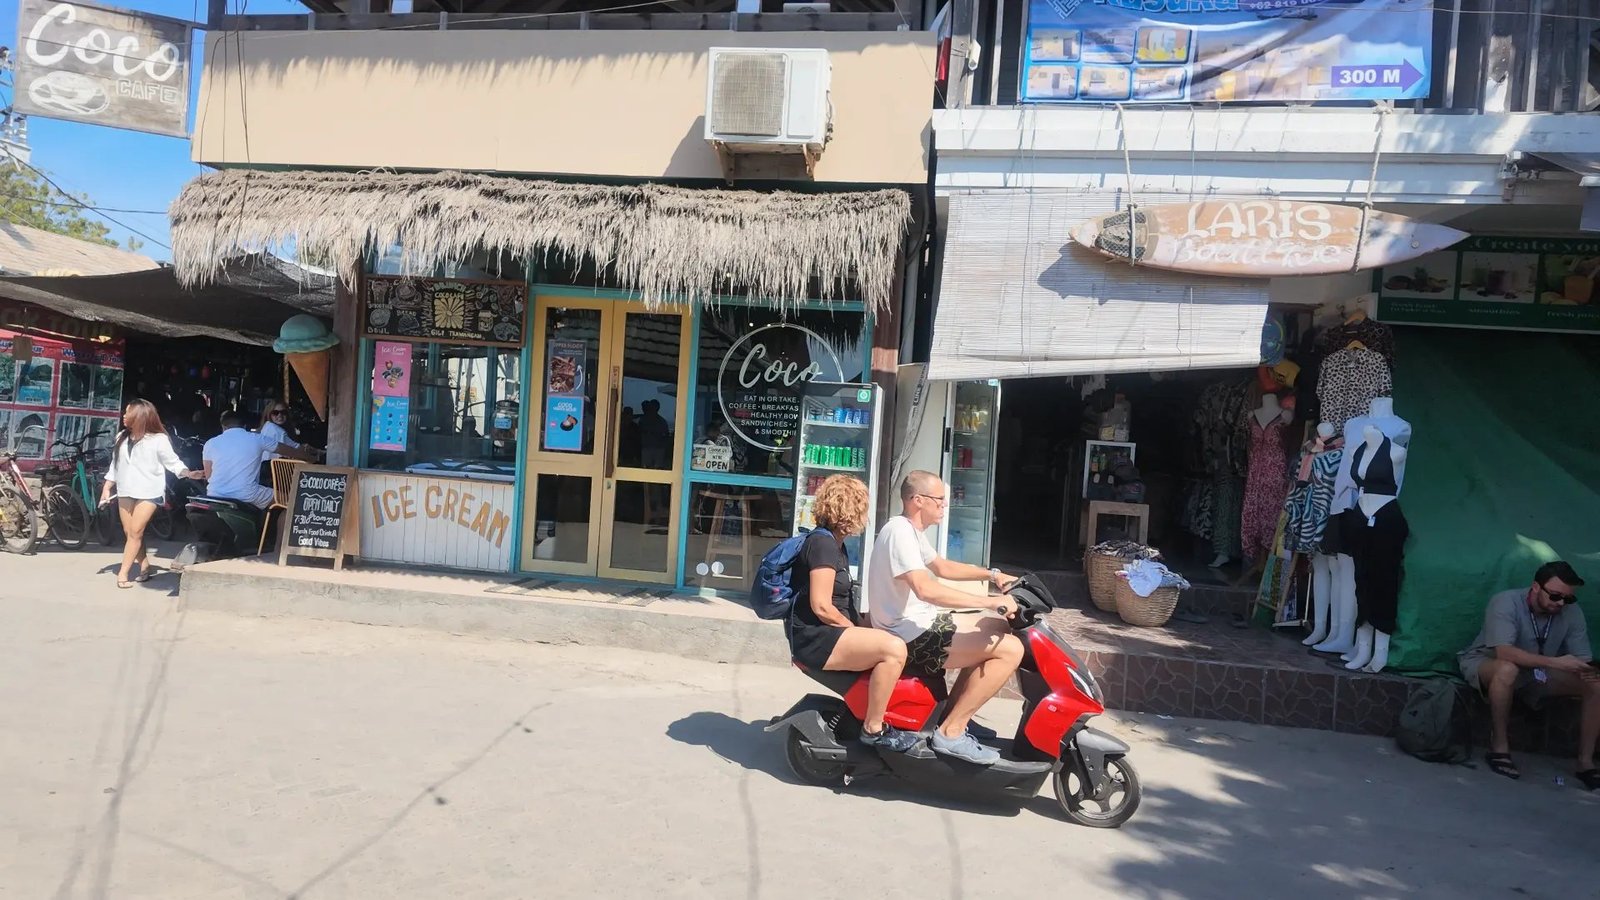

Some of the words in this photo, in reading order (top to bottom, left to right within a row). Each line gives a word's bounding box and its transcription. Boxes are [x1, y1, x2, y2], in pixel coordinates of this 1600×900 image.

[26, 3, 180, 82] Coco
[1339, 68, 1377, 84] 300
[1383, 69, 1400, 83] M
[115, 78, 178, 104] CAFE
[1474, 238, 1555, 250] Create
[1564, 242, 1600, 252] you
[739, 343, 823, 389] Coco
[750, 411, 783, 419] HEALTHY
[761, 404, 799, 412] BREAKFAS
[740, 420, 788, 428] SANDWICHES
[705, 460, 729, 470] OPEN
[302, 497, 321, 511] OPEN
[320, 499, 341, 513] DAILY
[371, 485, 417, 529] ICE
[424, 485, 510, 549] CREAM
